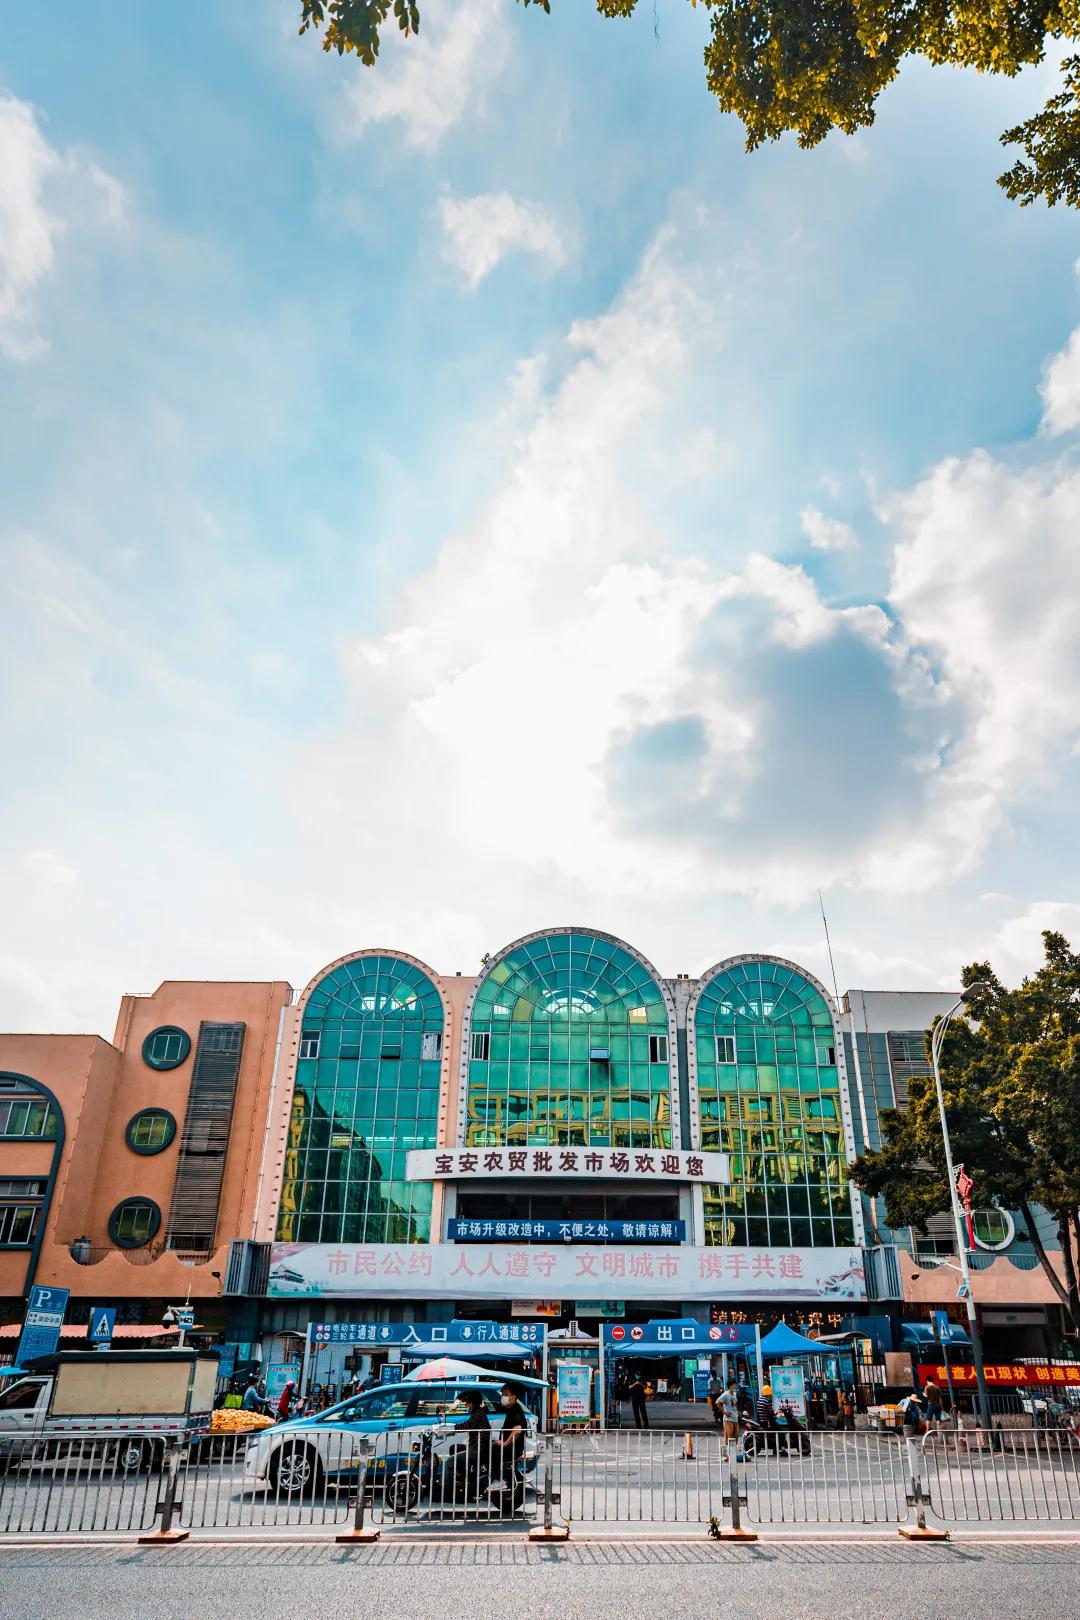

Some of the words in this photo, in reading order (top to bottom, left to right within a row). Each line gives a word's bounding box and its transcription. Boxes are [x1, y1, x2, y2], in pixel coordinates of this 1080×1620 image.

[435, 1151, 704, 1176] 宝安农贸批发市场欢迎您
[326, 1250, 433, 1277] 市民公约
[450, 1251, 557, 1278] 人人遵守
[575, 1252, 681, 1279] 文明城市
[698, 1253, 804, 1280] 携手共建
[34, 1289, 52, 1308] P
[332, 1324, 356, 1333] 电动车
[357, 1325, 377, 1341] 通道
[402, 1325, 447, 1342] 入口
[477, 1325, 520, 1341] 行人通道
[657, 1325, 695, 1341] 出口
[332, 1333, 356, 1341] 三轮车
